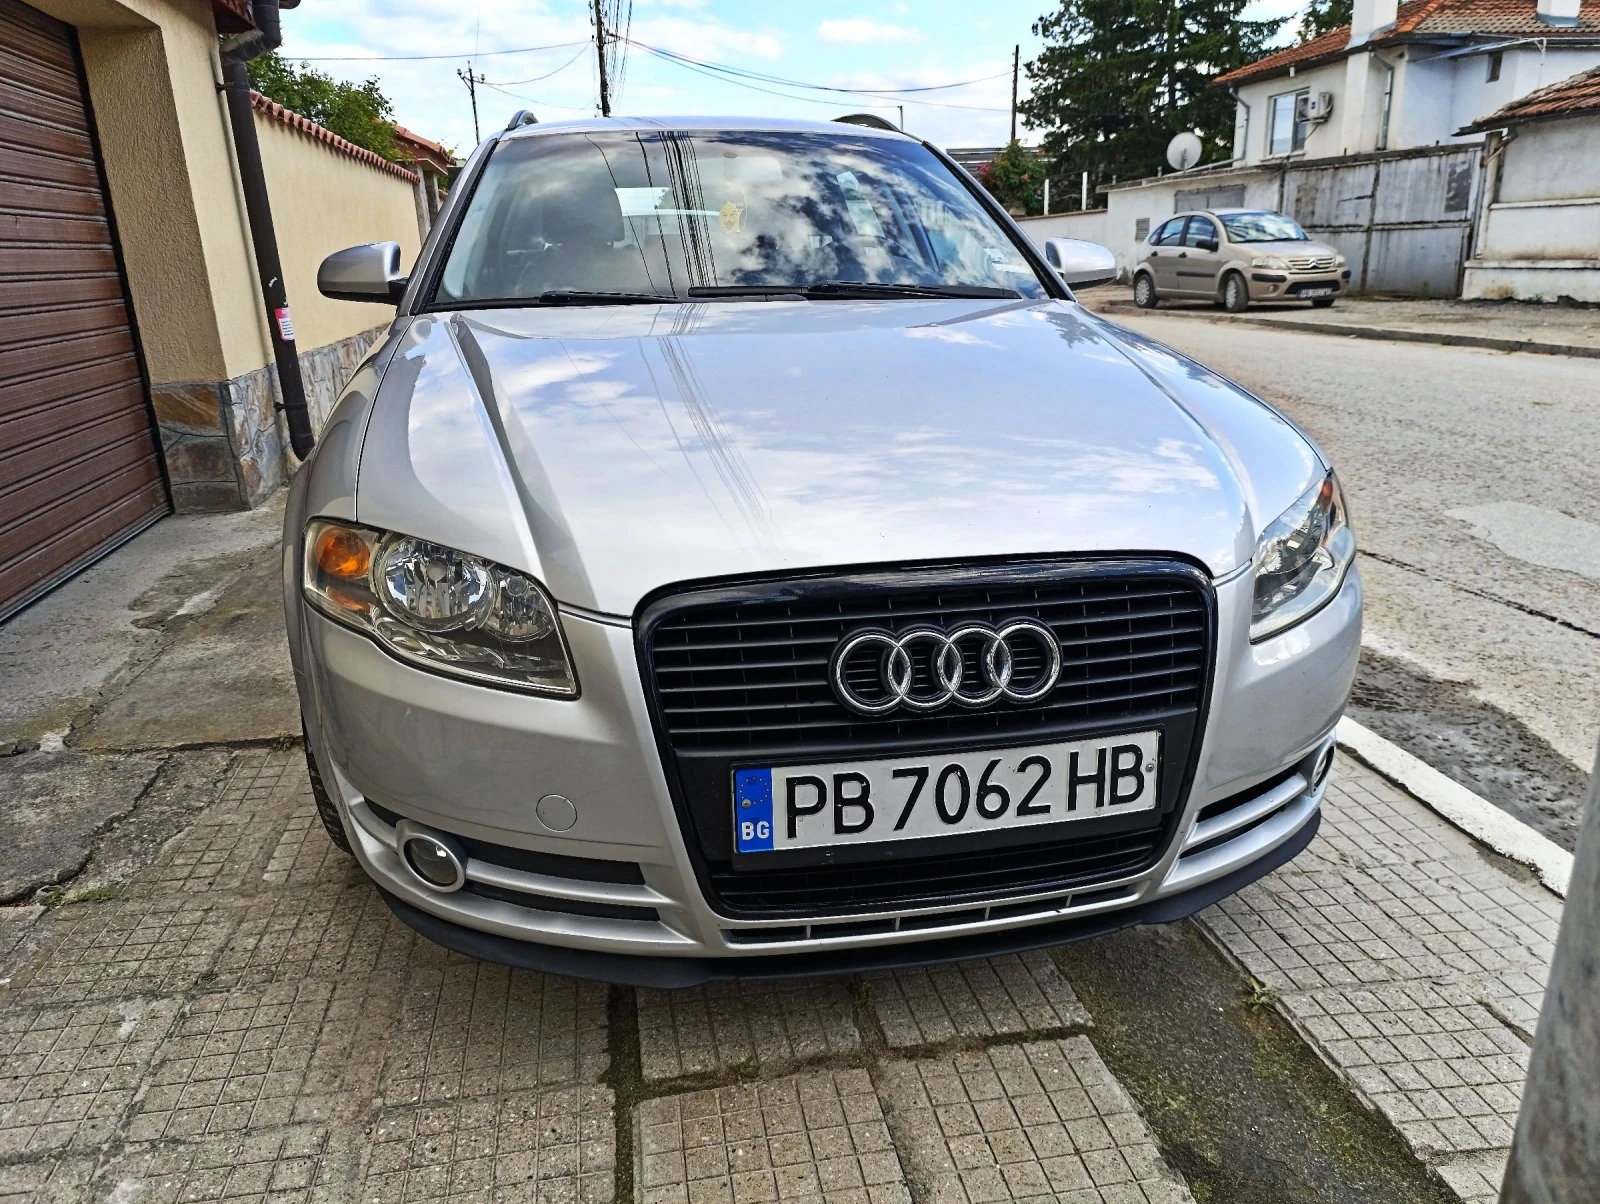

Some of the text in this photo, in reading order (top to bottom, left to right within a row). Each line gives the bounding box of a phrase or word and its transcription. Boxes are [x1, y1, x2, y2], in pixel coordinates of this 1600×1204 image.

[786, 744, 1145, 839] PB 7062 HB
[741, 821, 770, 840] BG
